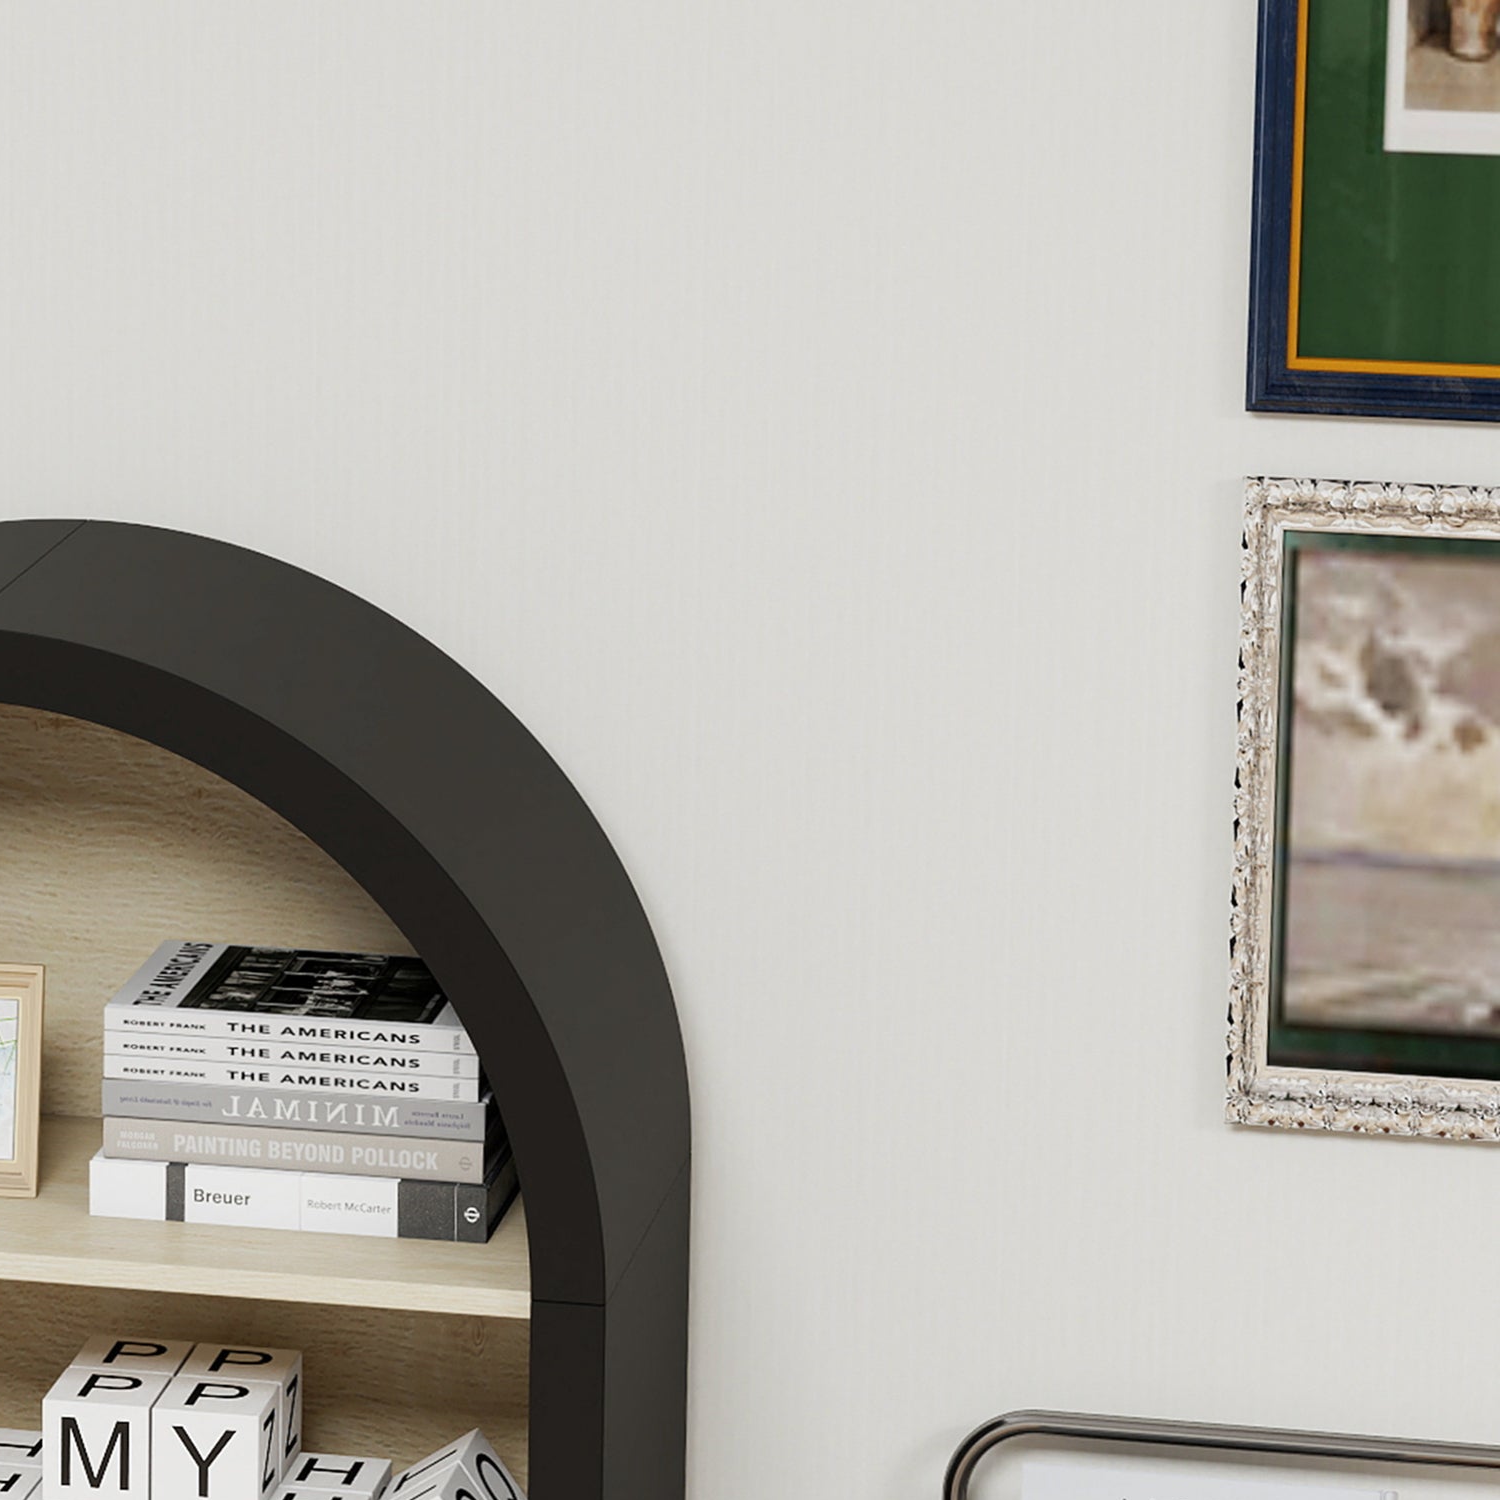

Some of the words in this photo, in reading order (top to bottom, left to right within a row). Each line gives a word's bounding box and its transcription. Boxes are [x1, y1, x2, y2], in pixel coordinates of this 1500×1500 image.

[150, 942, 213, 990] AMERICANS
[133, 990, 171, 1006] THE
[123, 1019, 166, 1029] ROBERT
[169, 1022, 206, 1031] FRANK
[227, 1022, 271, 1035] THE
[280, 1026, 421, 1044] AMERICANS
[123, 1043, 166, 1053] ROBERT
[169, 1046, 206, 1055] FRANK
[227, 1046, 271, 1059] THE
[280, 1050, 421, 1068] AMERICANS
[123, 1067, 166, 1077] ROBERT
[169, 1070, 206, 1079] FRANK
[227, 1070, 271, 1083] THE
[280, 1074, 421, 1092] AMERICANS
[173, 1134, 261, 1159] PAINTING
[267, 1142, 344, 1165] BEYOND
[351, 1148, 438, 1171] POLLOCK
[193, 1188, 251, 1207] Breuer
[307, 1198, 341, 1212] Robert
[344, 1202, 392, 1216] McCarter
[102, 1341, 167, 1364] P
[208, 1349, 274, 1372] P
[77, 1374, 143, 1398] P
[184, 1382, 250, 1405] P
[61, 1416, 237, 1499] MY
[296, 1458, 364, 1485] H
